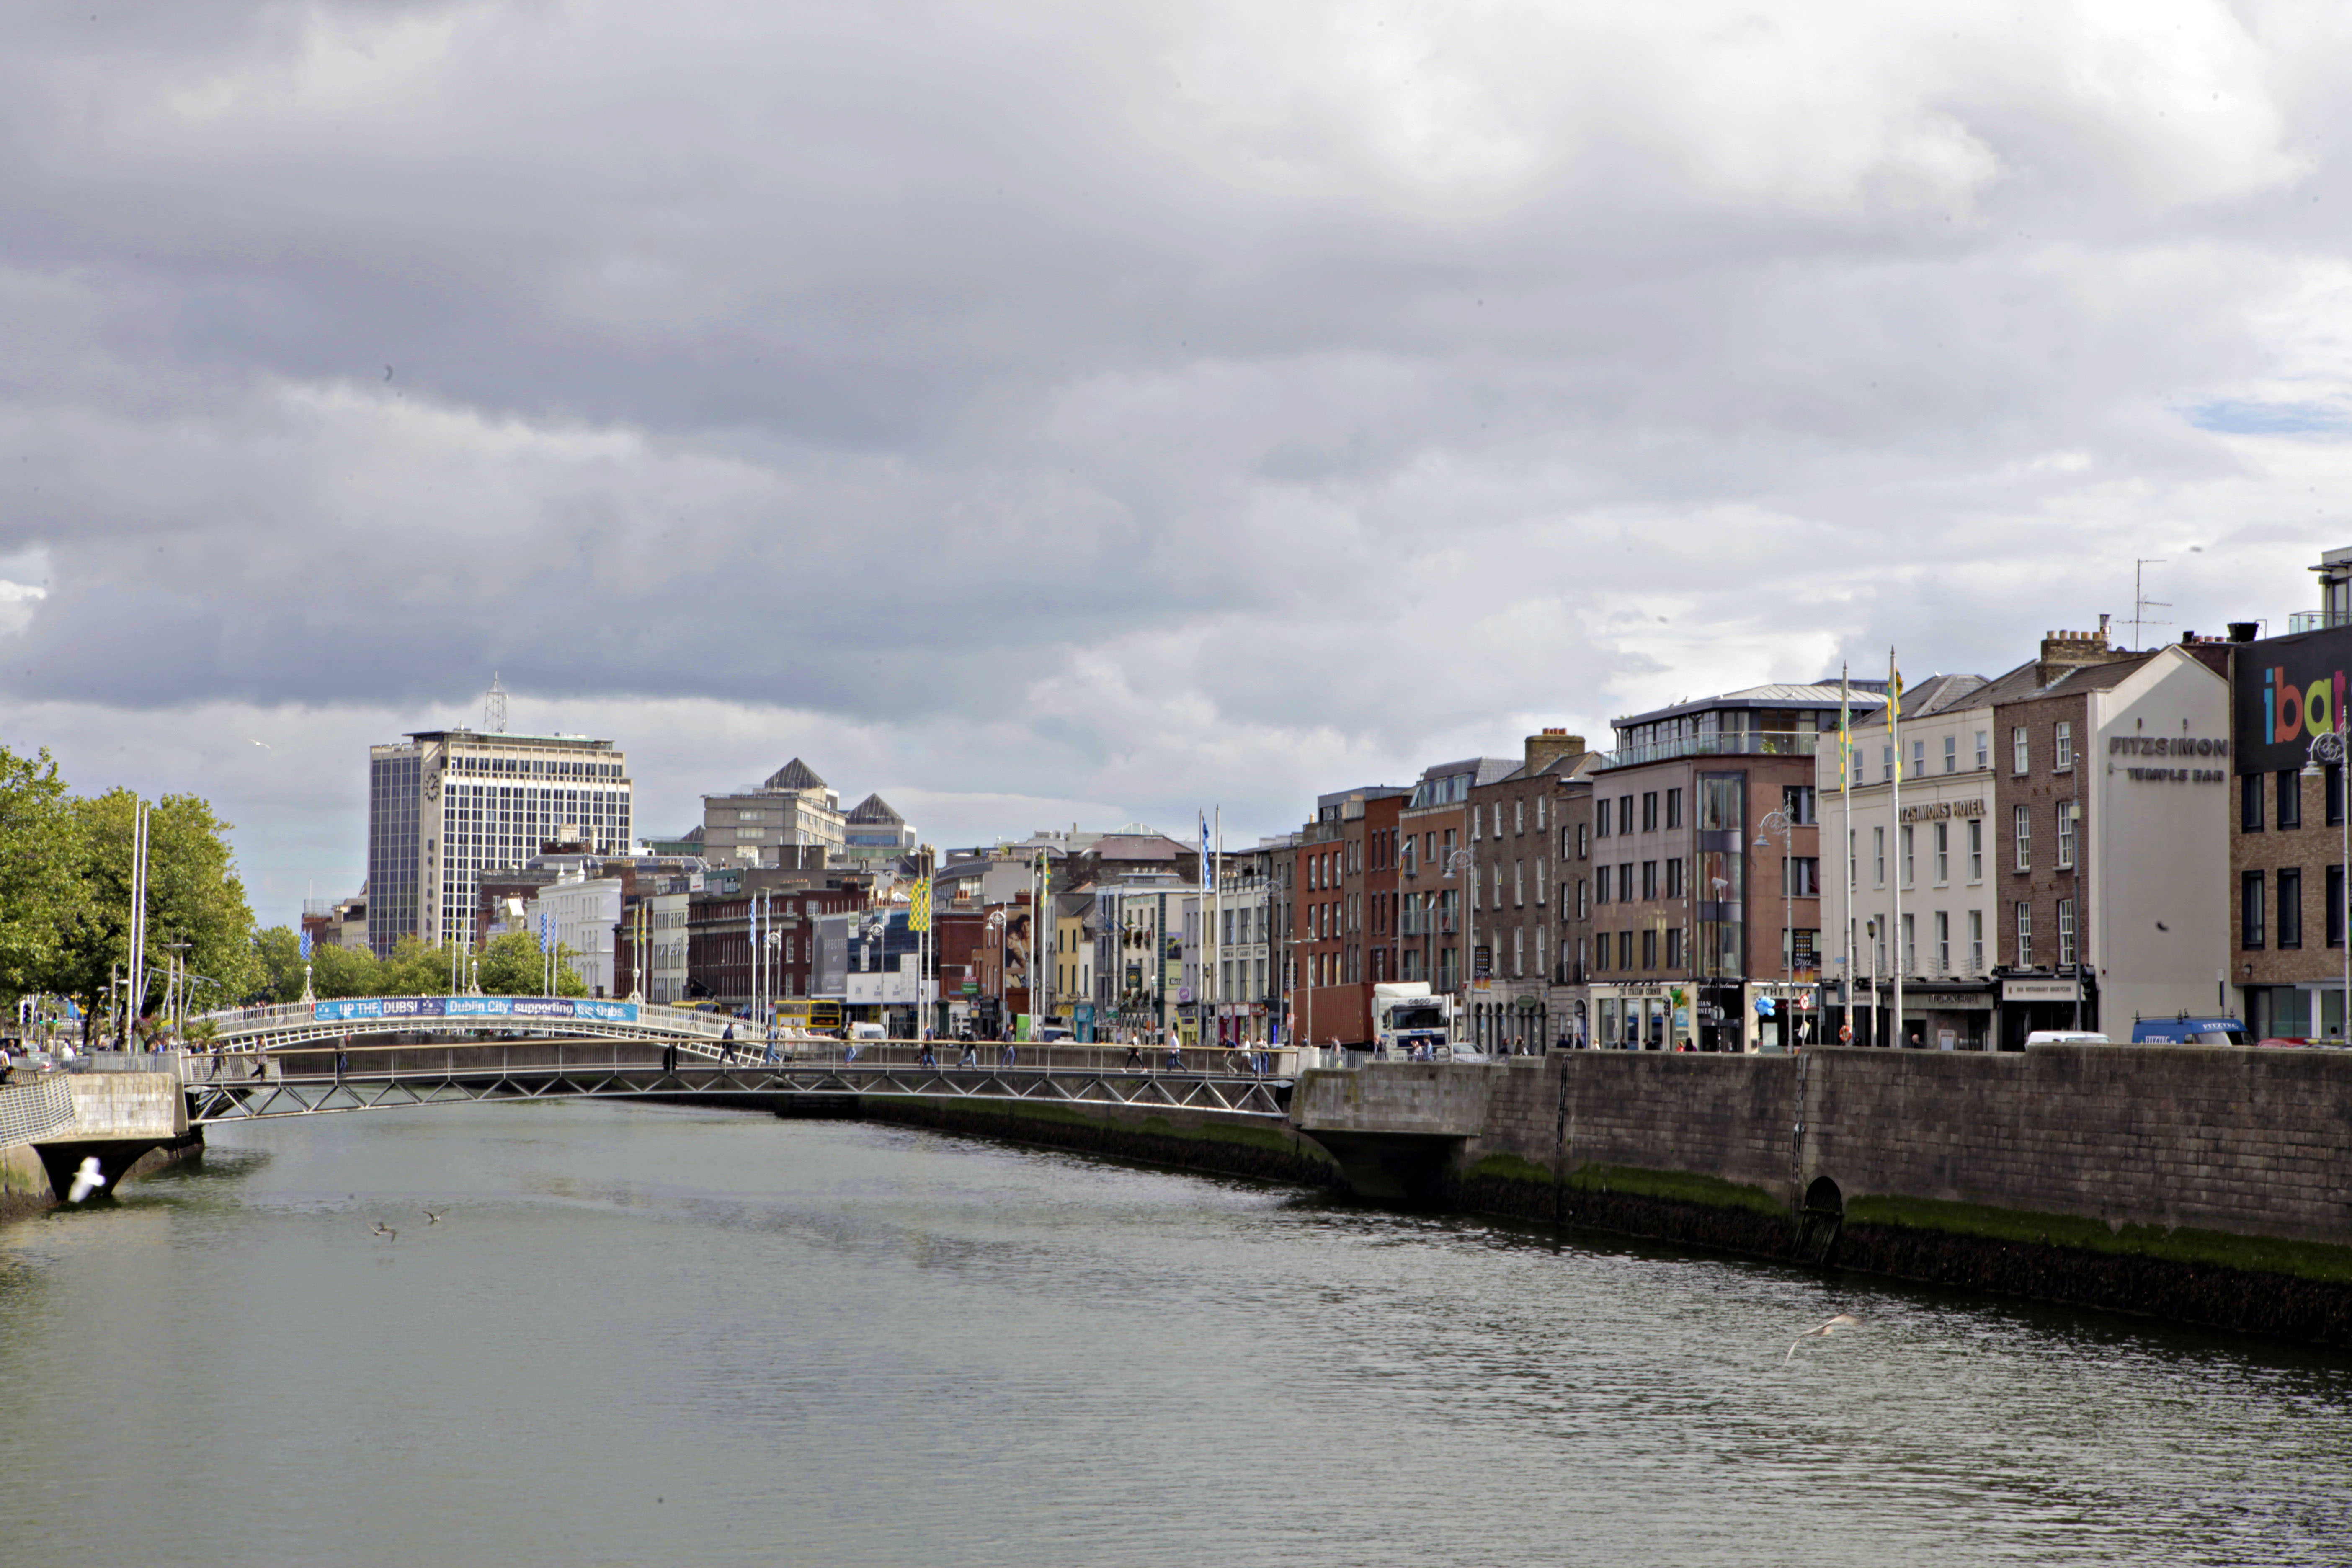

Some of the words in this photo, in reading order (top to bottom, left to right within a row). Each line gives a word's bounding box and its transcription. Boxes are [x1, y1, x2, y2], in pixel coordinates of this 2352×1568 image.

[2109, 736, 2228, 756] FITZSIMON
[2128, 767, 2188, 781] TEMPLE
[2192, 769, 2225, 782] BAR
[1952, 799, 1986, 817] HOTEL
[824, 938, 847, 950] SPECTRE
[1762, 987, 1784, 996] THE
[340, 1003, 355, 1016] UP
[357, 1002, 379, 1014] THE
[383, 1001, 418, 1014] DUBS!
[449, 1000, 485, 1012] Dublin
[487, 1000, 509, 1014] City
[514, 1001, 573, 1016] supporting
[2145, 1035, 2170, 1044] FITZTEC
